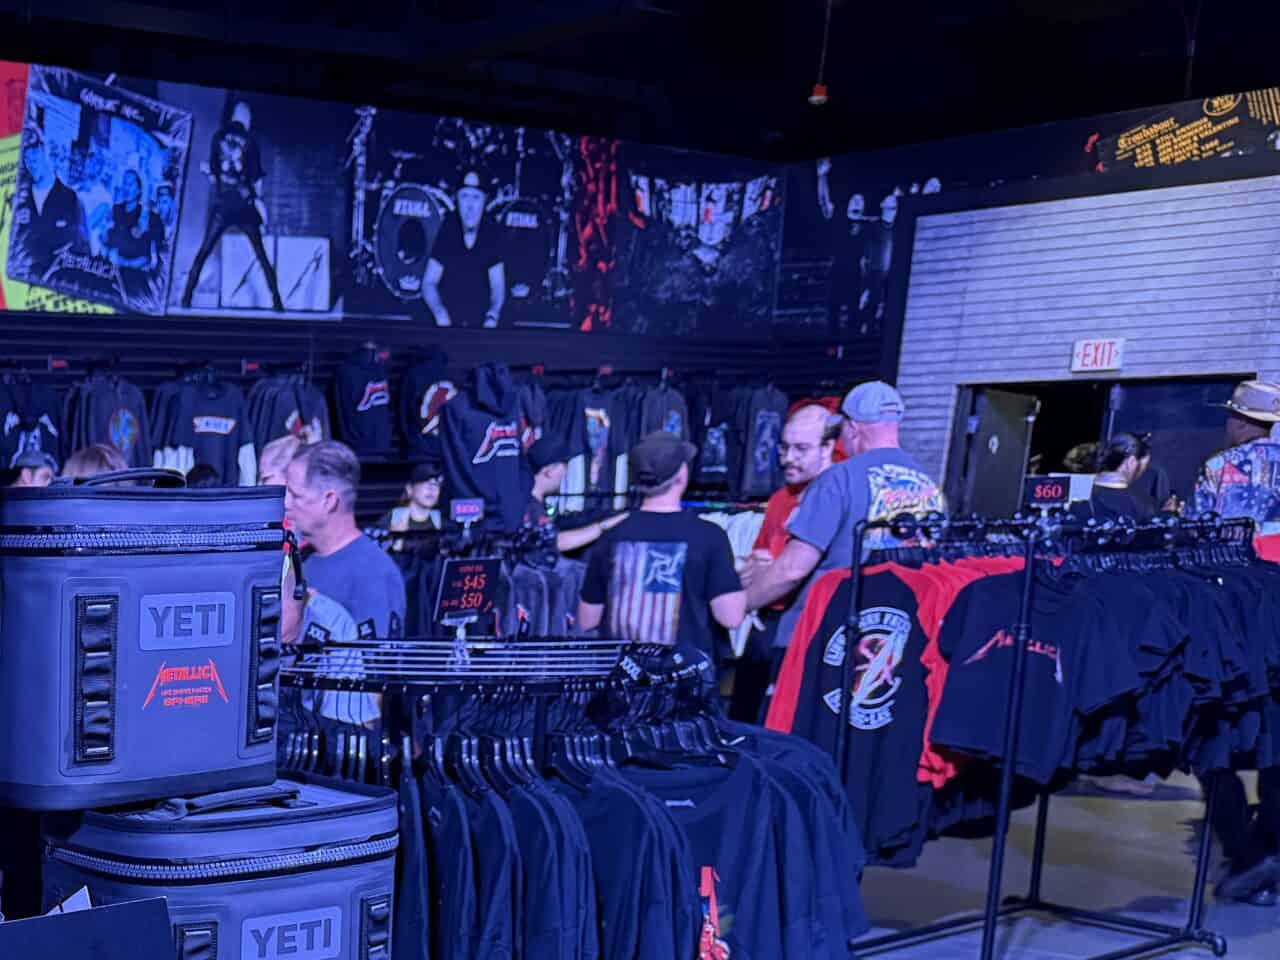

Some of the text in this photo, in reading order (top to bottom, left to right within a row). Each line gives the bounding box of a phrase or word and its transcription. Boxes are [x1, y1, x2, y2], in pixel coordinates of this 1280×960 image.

[1081, 341, 1116, 367] EXIT
[1034, 484, 1063, 499] $60
[148, 603, 225, 638] YETI
[142, 656, 229, 710] METALLICA
[250, 918, 332, 958] YETI
